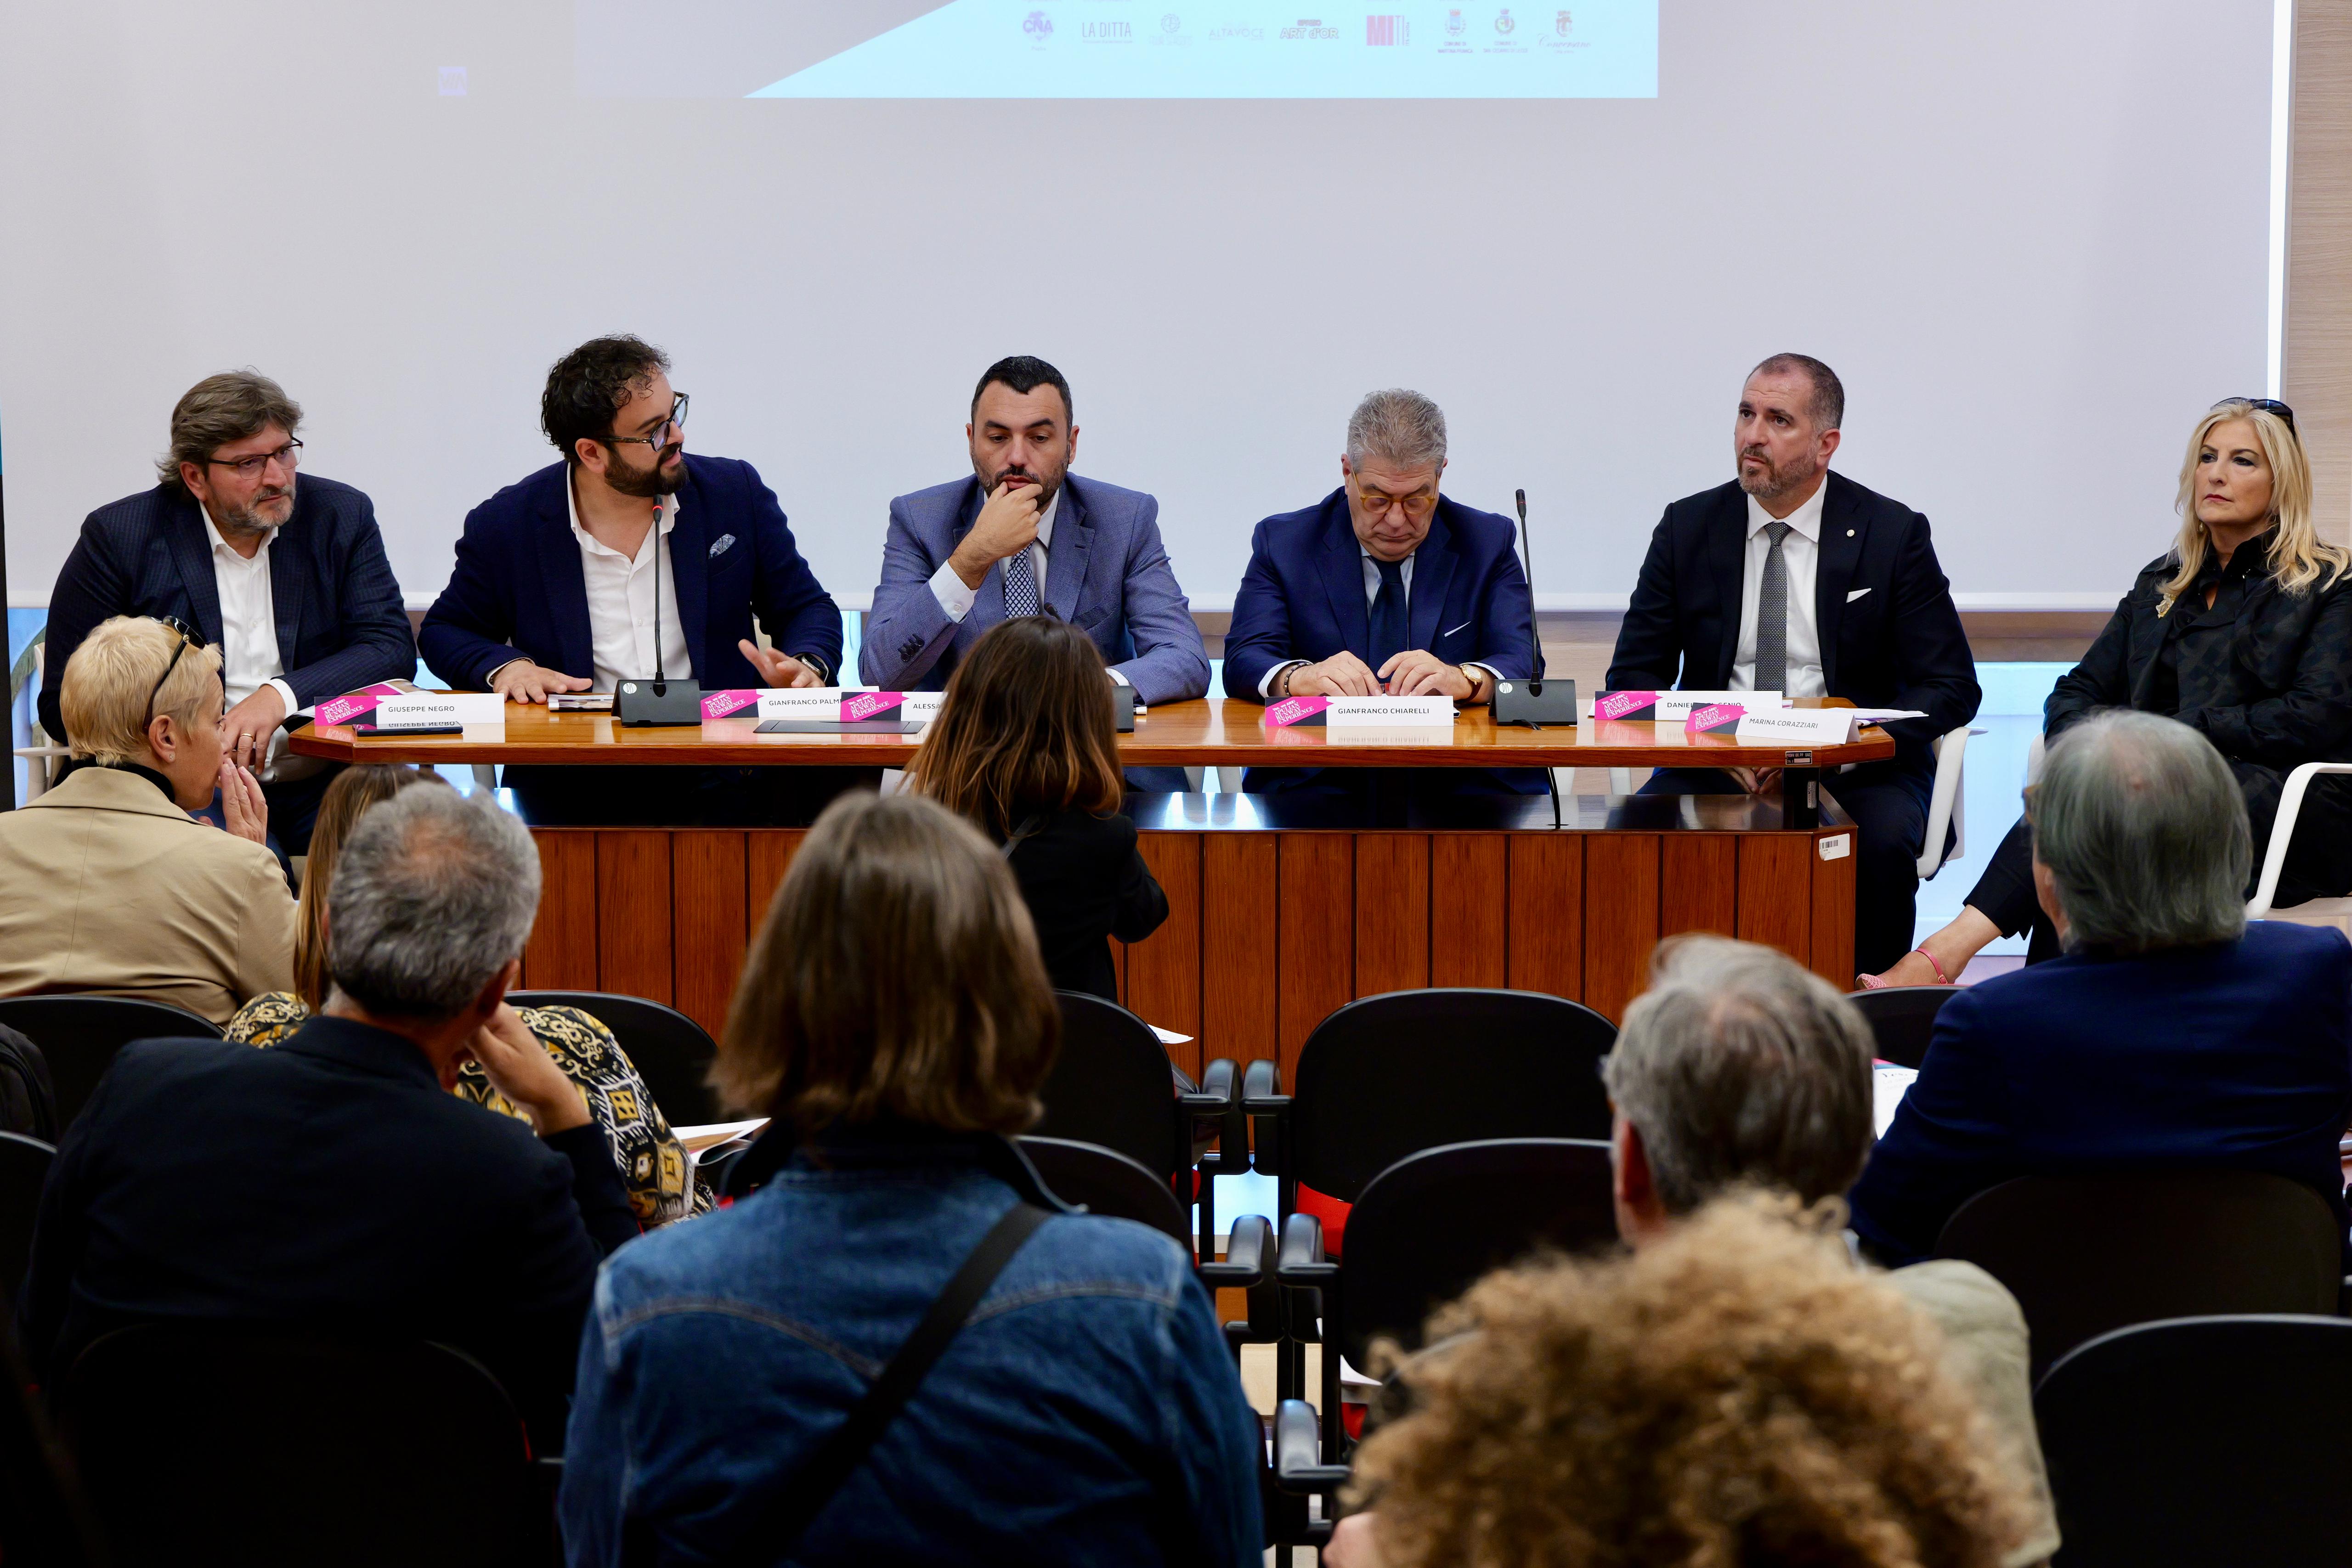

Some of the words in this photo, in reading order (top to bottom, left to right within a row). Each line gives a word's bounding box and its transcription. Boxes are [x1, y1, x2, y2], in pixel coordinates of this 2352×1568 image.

[1023, 19, 1054, 33] CNA
[1082, 22, 1096, 38] LA
[1099, 22, 1132, 38] DITTA
[1209, 28, 1264, 38] ALTAVOCE
[1279, 28, 1306, 39] ART
[1309, 28, 1340, 39] d'OR
[1537, 33, 1591, 47] Conversano
[324, 701, 349, 715] APULIAN
[707, 695, 731, 709] APULIAN
[708, 699, 733, 713] RUNWAY
[711, 699, 746, 717] EXPERIENCE
[850, 697, 875, 710] APULIAN
[851, 701, 876, 714] RUNWAY
[1275, 702, 1300, 716] APULIAN
[1604, 696, 1629, 710] APULIAN
[1604, 699, 1630, 714] RUNWAY
[1606, 699, 1643, 718] EXPERIENCE
[325, 705, 351, 720] RUNWAY
[327, 705, 364, 723] EXPERIENCE
[853, 700, 889, 719] EXPERIENCE
[1275, 706, 1301, 721] RUNWAY
[1278, 706, 1314, 724] EXPERIENCE
[1696, 709, 1719, 721] APULIAN
[1696, 713, 1719, 725] RUNWAY
[1696, 714, 1730, 729] EXPERIENCE
[1777, 720, 1818, 728] CORAZZIARI
